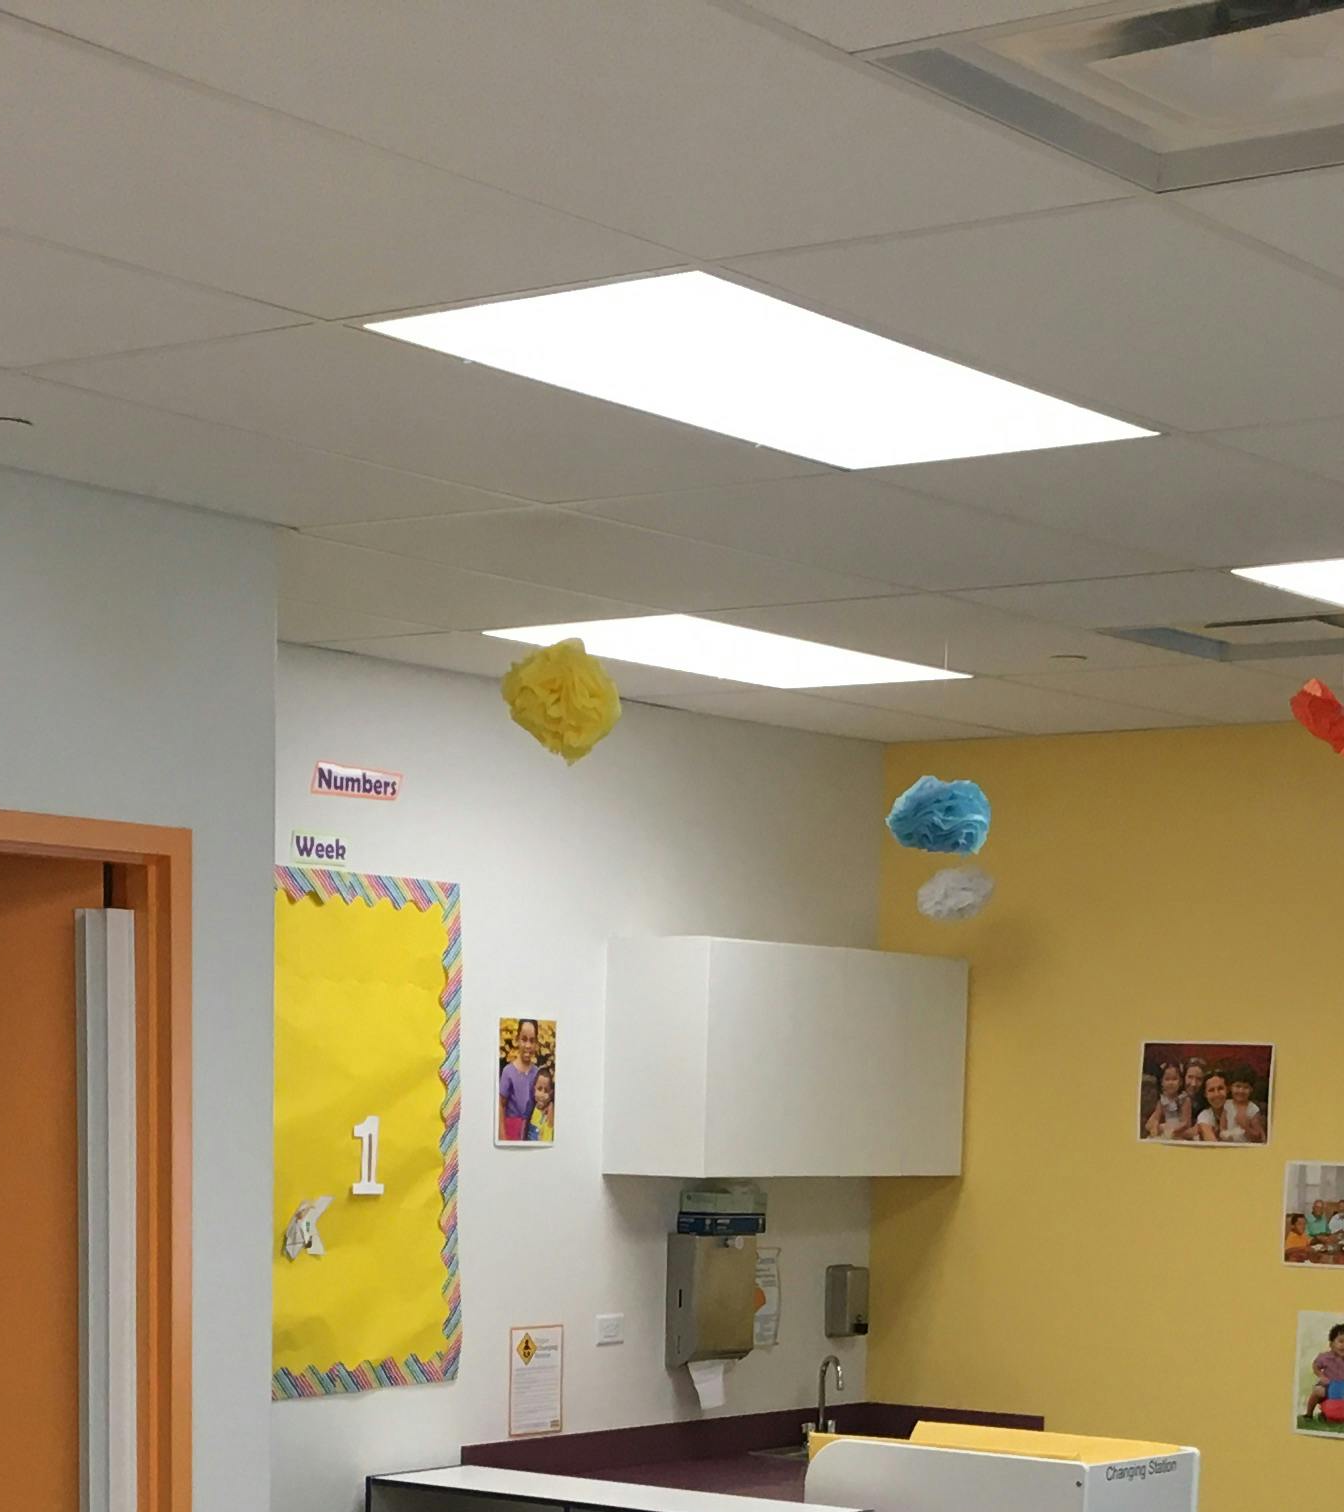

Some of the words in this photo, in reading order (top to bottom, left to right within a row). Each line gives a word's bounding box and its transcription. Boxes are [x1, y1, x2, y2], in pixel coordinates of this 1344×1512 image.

[317, 767, 397, 796] Numbers
[296, 835, 347, 860] Week
[350, 1115, 385, 1195] 1
[1105, 1464, 1146, 1481] Changing
[1148, 1458, 1178, 1475] Station
